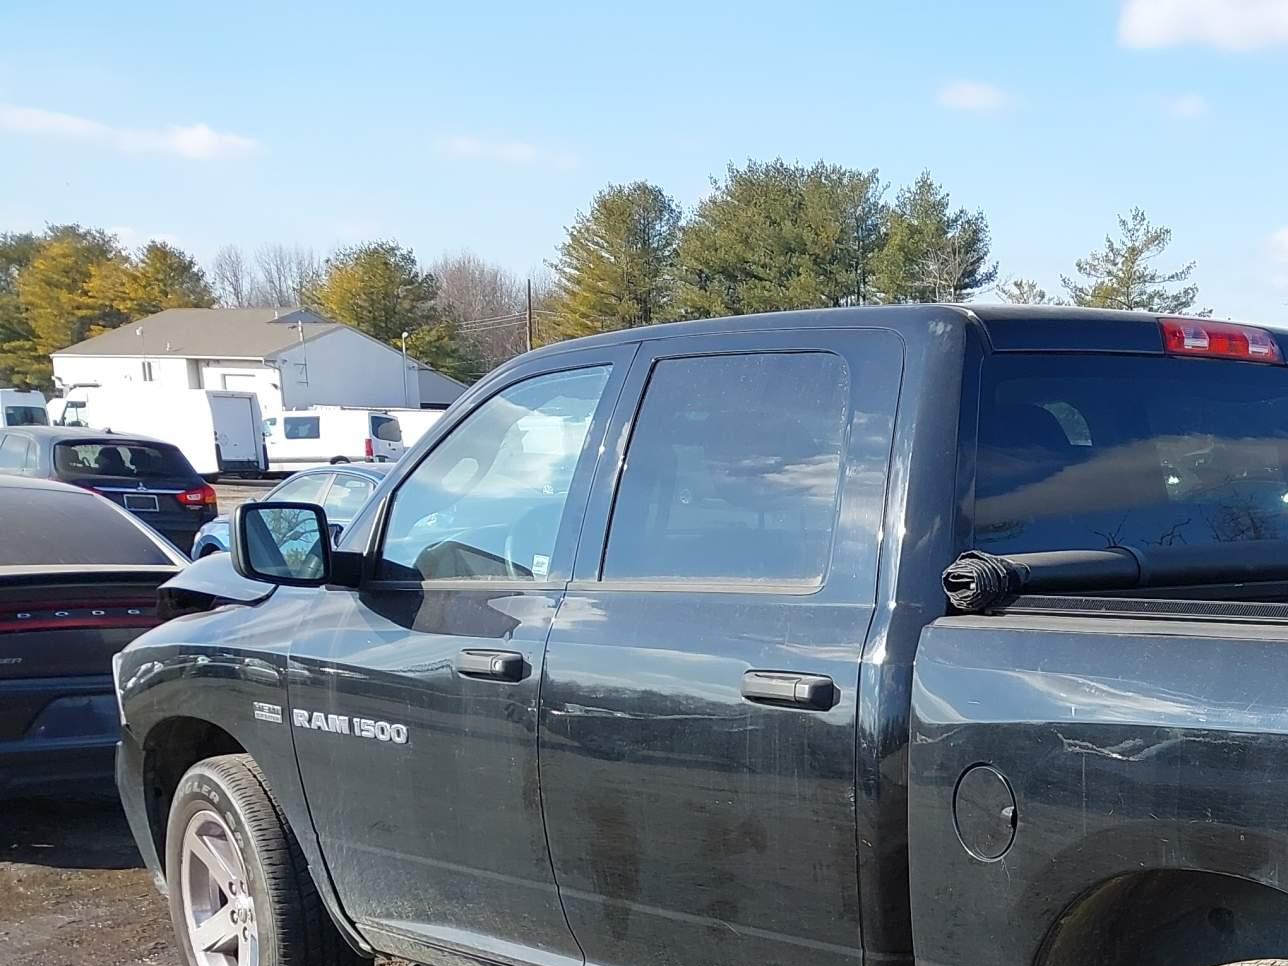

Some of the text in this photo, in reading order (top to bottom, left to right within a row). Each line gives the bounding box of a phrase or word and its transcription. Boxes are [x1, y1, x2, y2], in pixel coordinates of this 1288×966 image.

[16, 609, 141, 619] DODG
[293, 709, 350, 735] RAM
[352, 718, 408, 744] 1500
